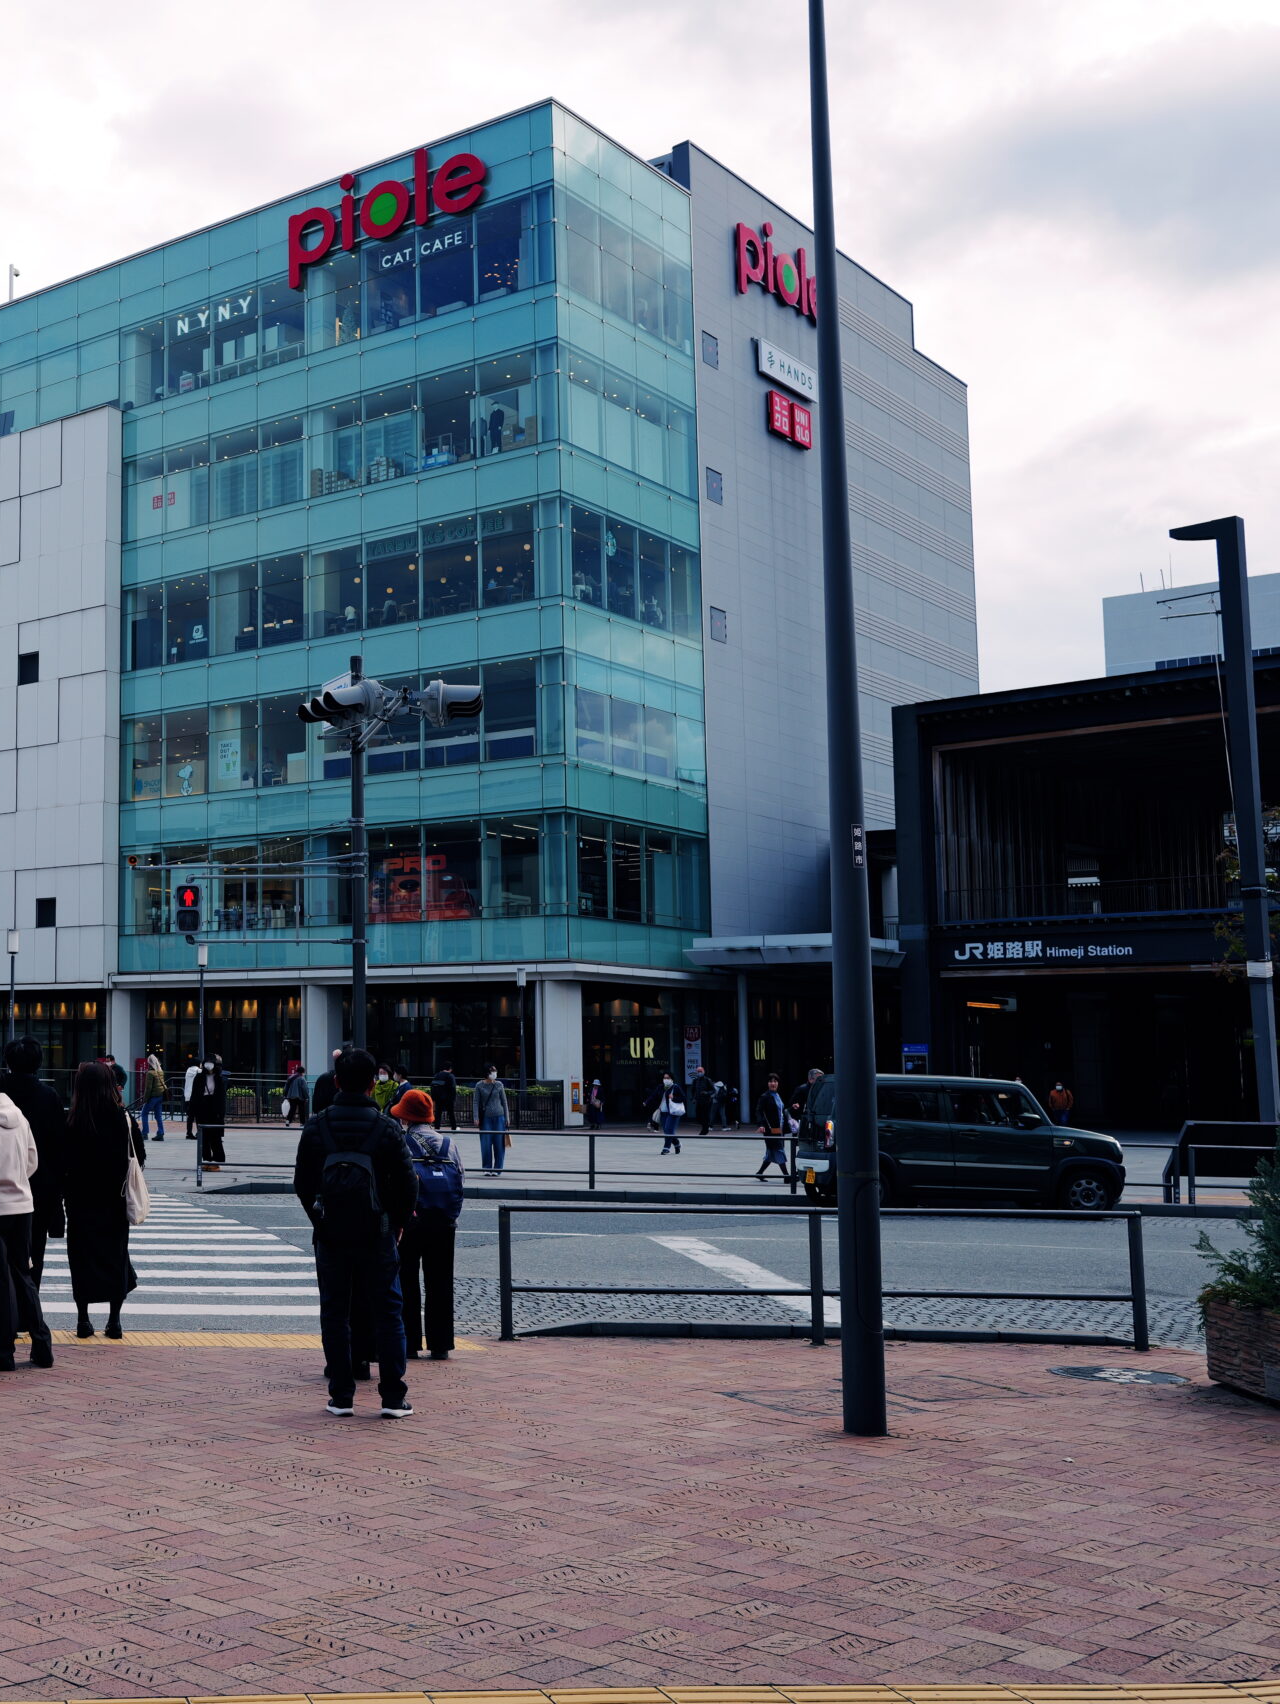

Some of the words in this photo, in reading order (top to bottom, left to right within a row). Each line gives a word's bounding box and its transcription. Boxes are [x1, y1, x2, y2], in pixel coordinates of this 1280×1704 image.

[288, 148, 487, 289] piole
[381, 247, 413, 269] CAT
[420, 231, 463, 256] CAFE
[779, 360, 813, 390] HANDS
[853, 827, 863, 864] 姫路市
[383, 854, 447, 873] PRO
[1046, 946, 1084, 959] Himeji
[1087, 945, 1133, 957] Station
[629, 1037, 655, 1059] UR
[754, 1040, 766, 1060] UR
